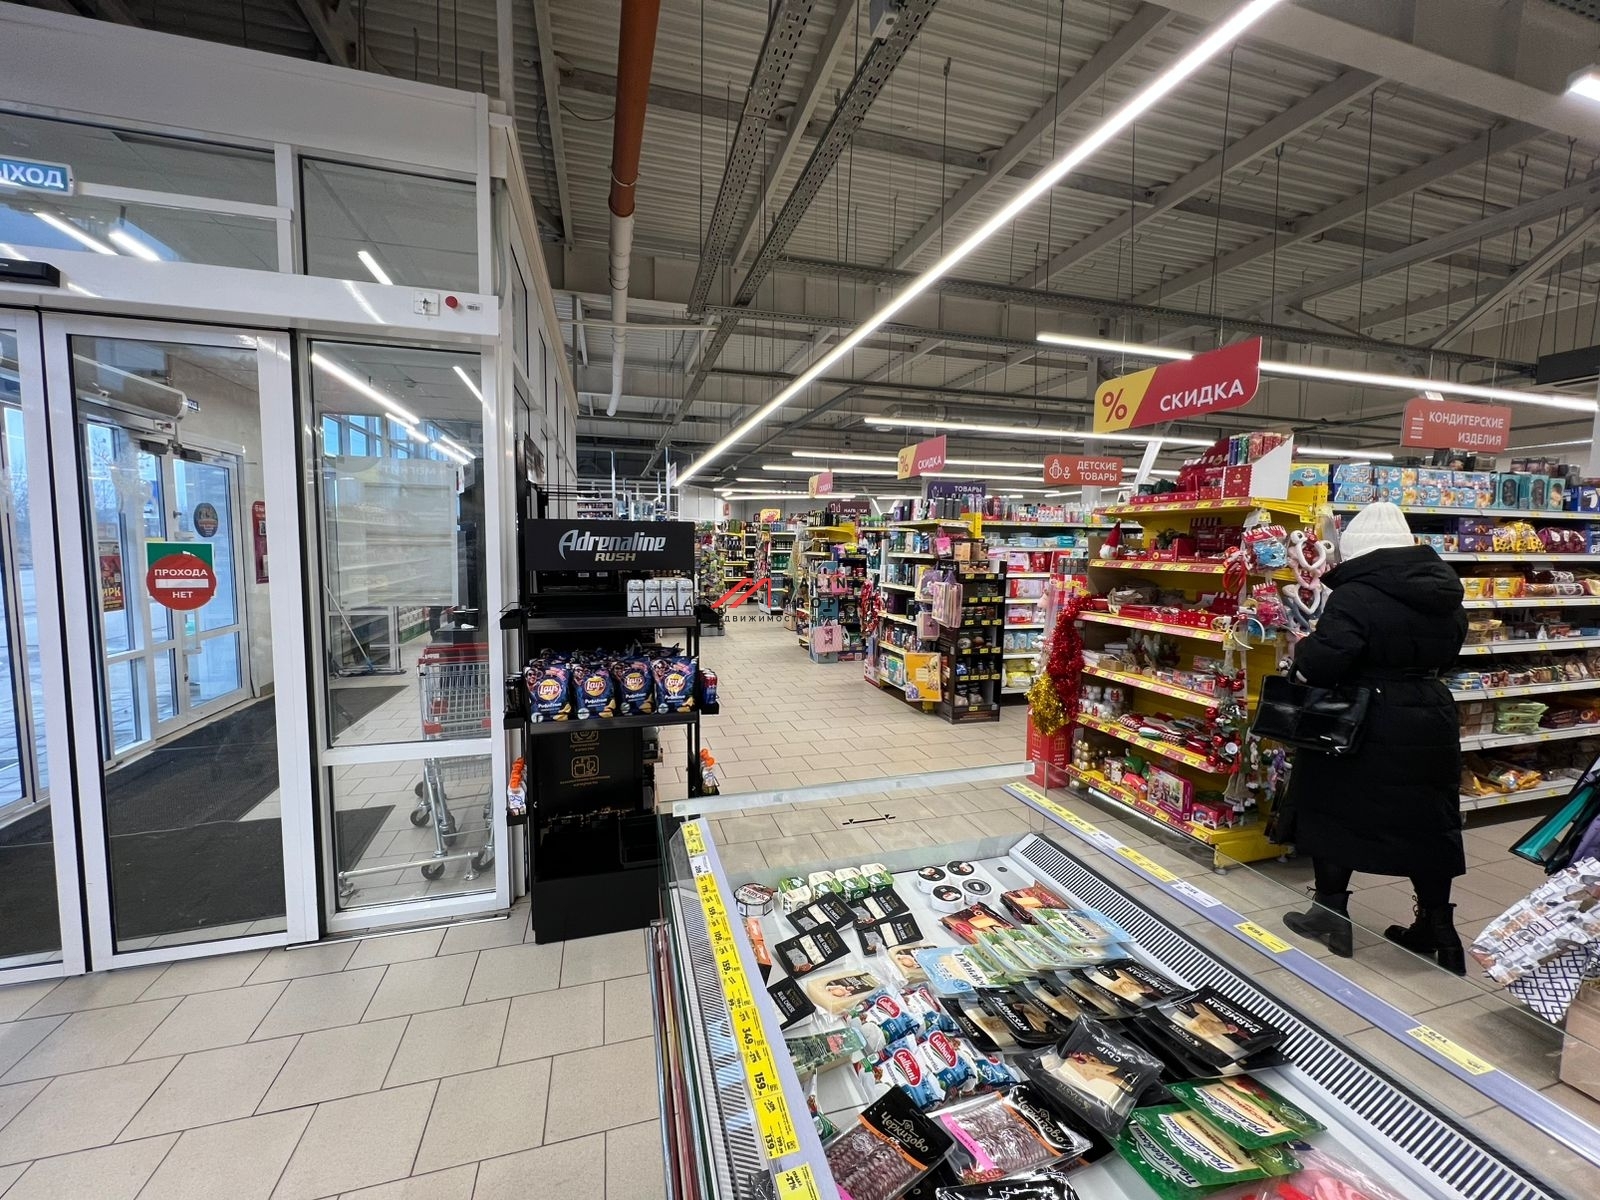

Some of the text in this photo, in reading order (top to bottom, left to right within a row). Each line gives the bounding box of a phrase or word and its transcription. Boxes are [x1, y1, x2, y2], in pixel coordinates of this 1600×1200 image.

[1160, 378, 1244, 412] СКИДКА
[1428, 411, 1504, 429] КОНДИТЕРСКИЕ
[1457, 432, 1502, 446] ИЗДЕЛИЯ
[918, 455, 942, 470] СКИДКА
[1077, 460, 1118, 471] ДЕТСКИЕ
[1080, 471, 1117, 482] ТОВАРЫ
[954, 485, 983, 493] ТОВАРЫ
[558, 529, 667, 560] Adrenaline
[594, 552, 637, 562] RUSH
[154, 568, 208, 577] ПРОХОДА
[172, 591, 193, 599] НЕТ
[1502, 913, 1563, 952] PEOPLE
[1126, 966, 1172, 995] PARMESAN
[783, 999, 796, 1013] CHEESE
[993, 996, 1030, 1032] PARMESAN
[1205, 998, 1260, 1034] PARMESAN
[932, 1035, 954, 1065] Galbani
[1096, 1045, 1121, 1063] СЫР
[897, 1052, 918, 1082] Galbani
[1017, 1096, 1067, 1143] Черкизово
[881, 1111, 929, 1153] Черкизово
[1165, 1116, 1235, 1171] Белебеевский
